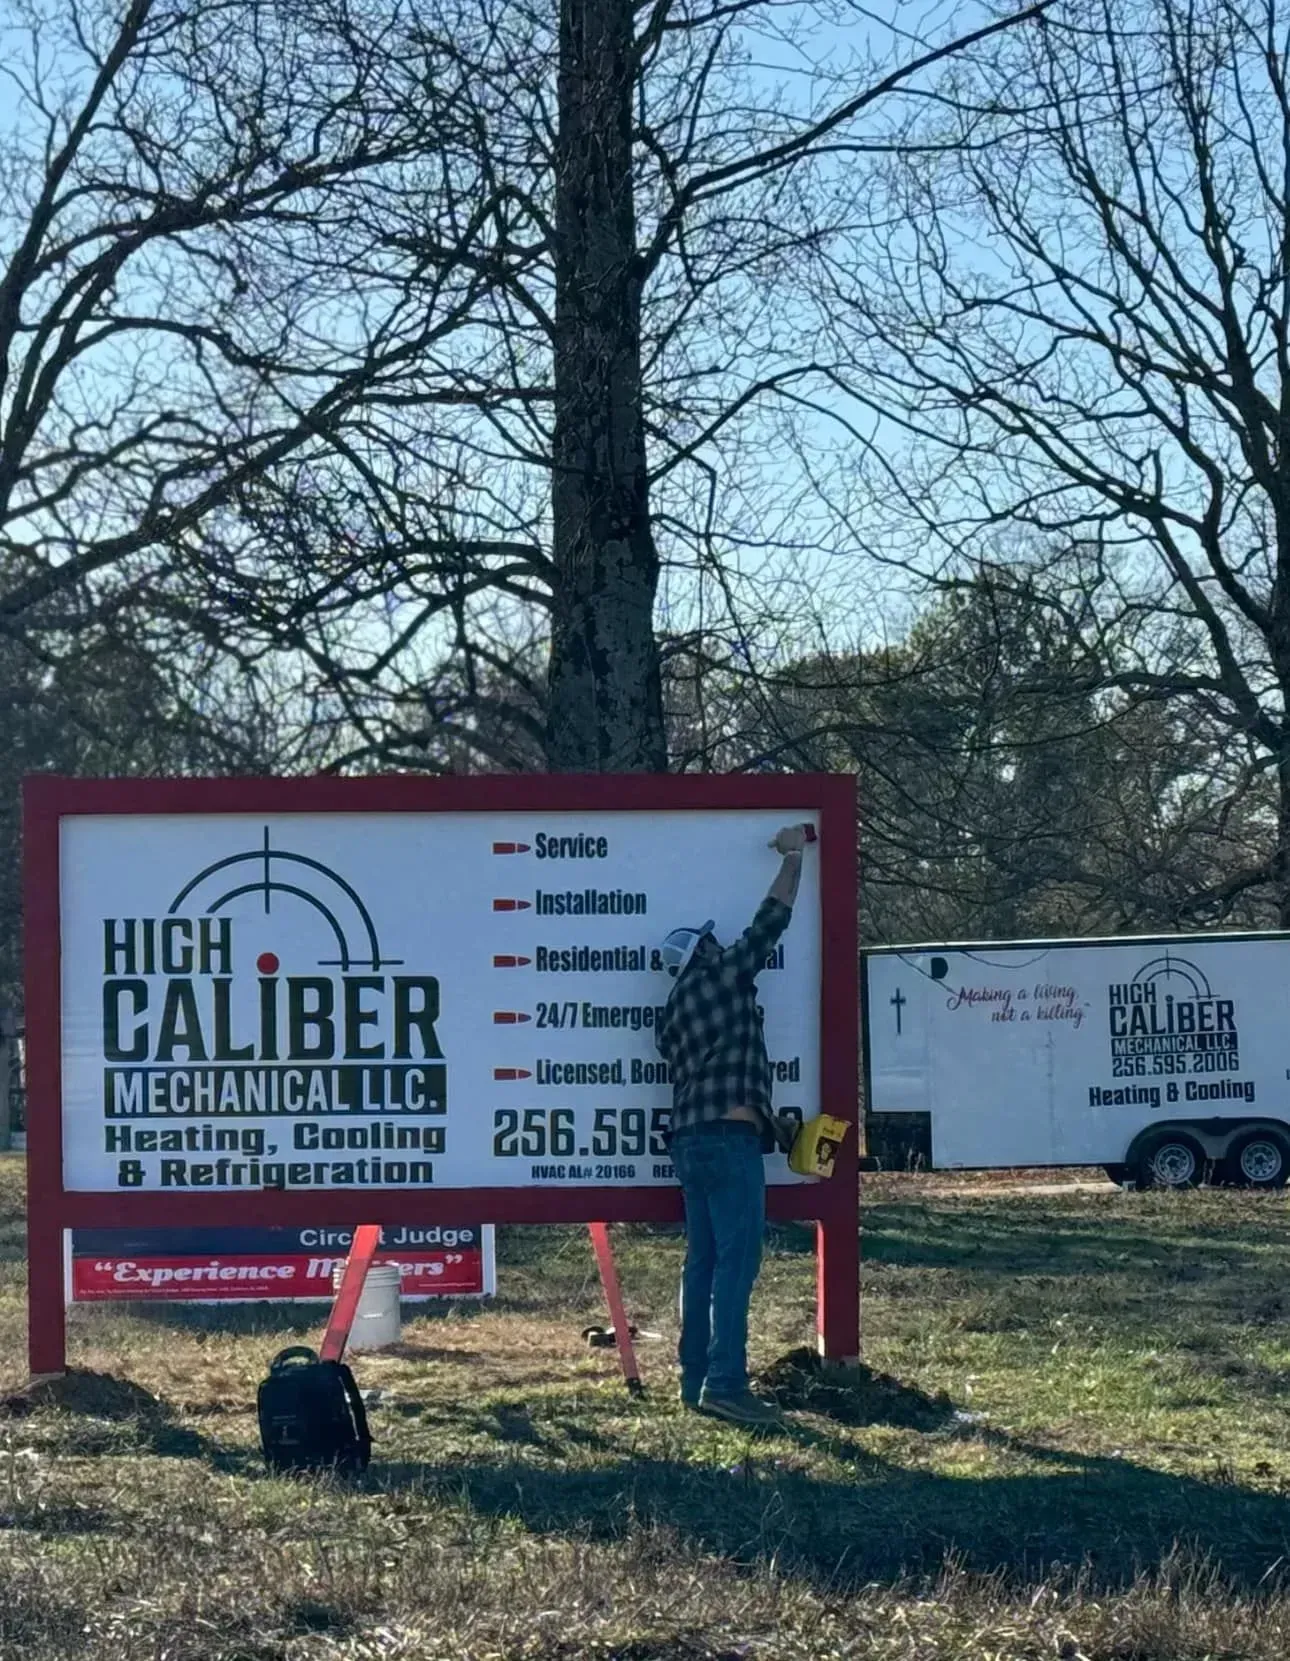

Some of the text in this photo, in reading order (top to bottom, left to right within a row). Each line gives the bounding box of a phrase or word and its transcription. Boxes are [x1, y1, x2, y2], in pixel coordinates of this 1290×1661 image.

[535, 832, 608, 859] Service
[535, 889, 647, 915] Installation
[103, 918, 233, 975] HIGH
[536, 945, 664, 972] Residential &
[946, 985, 1013, 1013] Making
[1017, 989, 1027, 1000] a
[1109, 982, 1157, 1005] HIGH
[535, 1002, 663, 1030] 24/7 Emerge
[991, 1007, 1015, 1022] not
[1020, 1010, 1031, 1021] a
[1114, 1033, 1235, 1056] MECHANICAL LLC.
[536, 1059, 673, 1086] Licensed, Bon
[1112, 1052, 1239, 1077] 256.595.2006
[113, 1068, 438, 1114] MECHANICAL LLC.
[1089, 1079, 1254, 1107] Heating & Cooling
[104, 1122, 446, 1156] Heating, Cooling
[118, 1157, 433, 1191] & Refrigeration
[531, 1165, 565, 1178] HVAC
[299, 1226, 474, 1247] Circt Judge
[306, 1254, 464, 1279] Mers”
